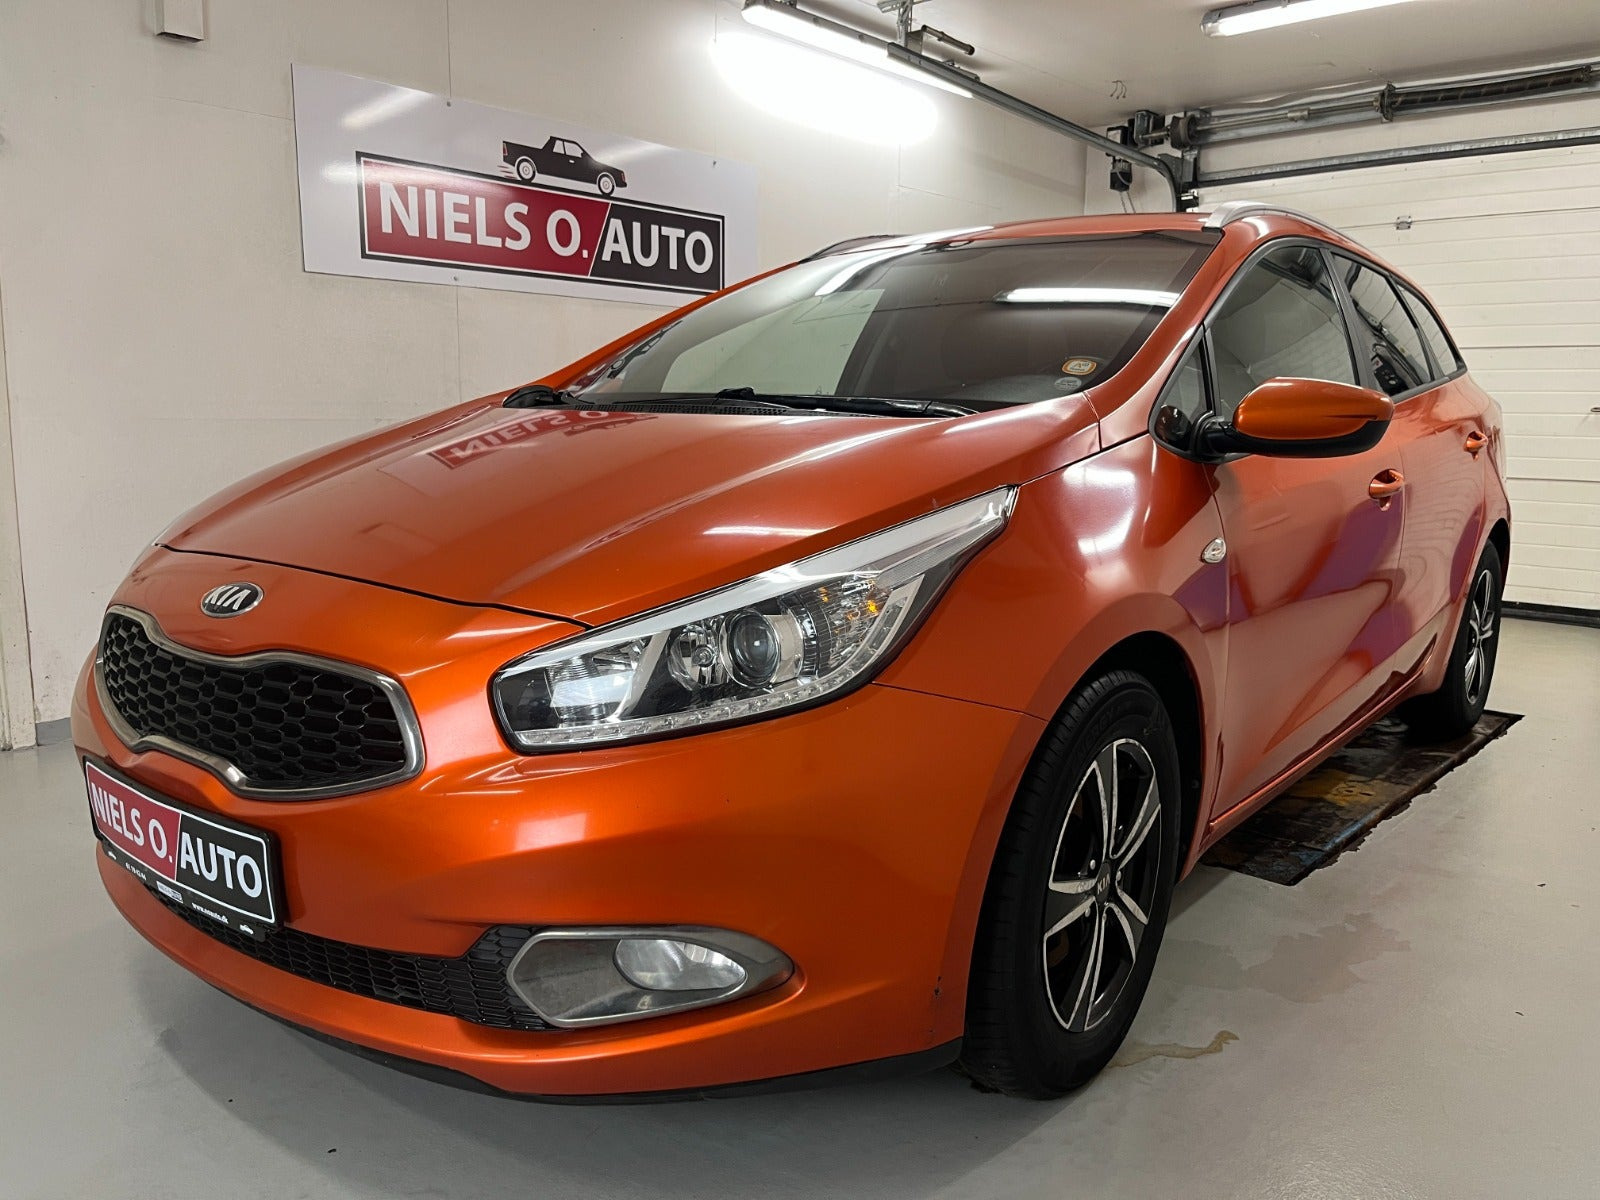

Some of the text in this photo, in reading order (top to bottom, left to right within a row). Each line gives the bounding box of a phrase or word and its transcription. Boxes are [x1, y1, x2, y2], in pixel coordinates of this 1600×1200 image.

[379, 180, 714, 274] NIELS O. AUTO
[204, 585, 252, 610] KIA
[90, 782, 263, 898] NIELS O. AUTO
[1097, 873, 1111, 895] KIA
